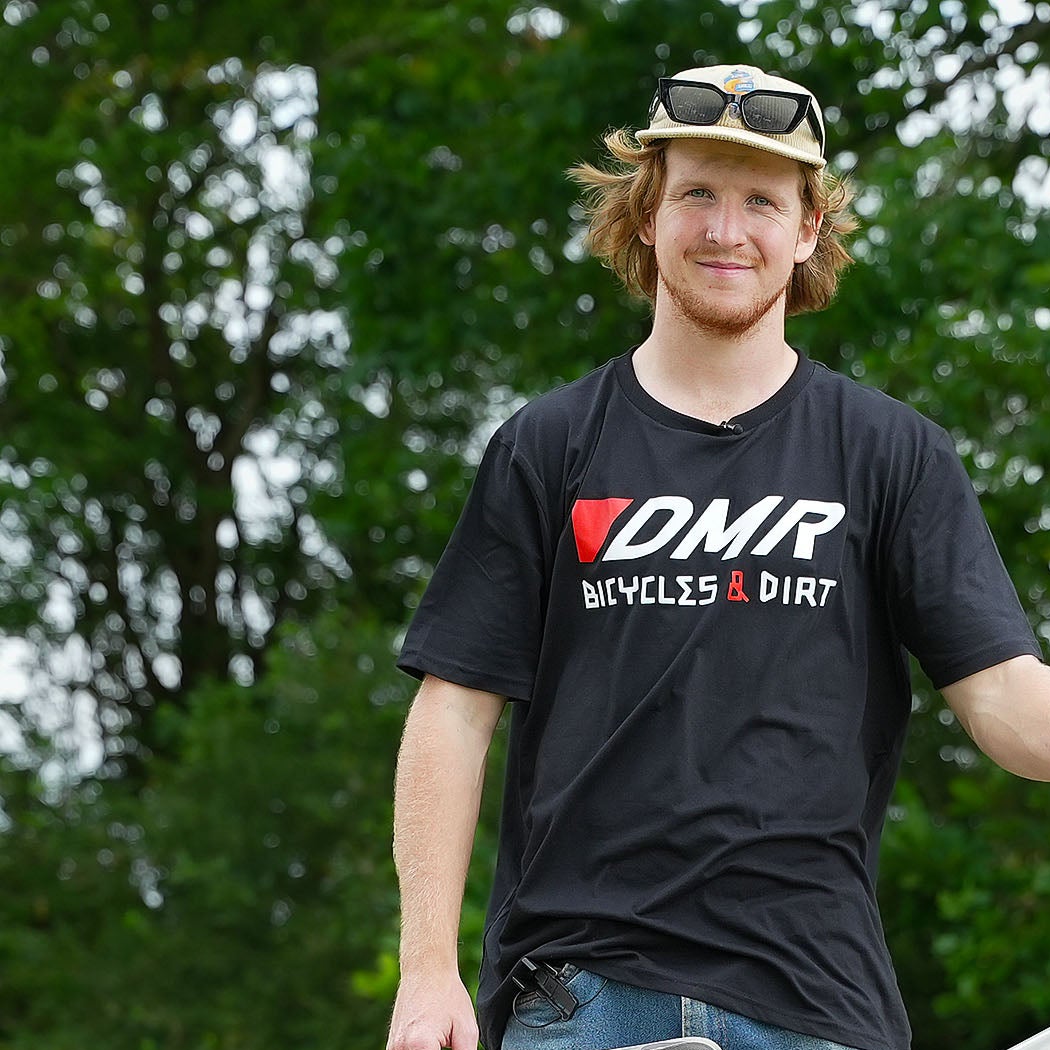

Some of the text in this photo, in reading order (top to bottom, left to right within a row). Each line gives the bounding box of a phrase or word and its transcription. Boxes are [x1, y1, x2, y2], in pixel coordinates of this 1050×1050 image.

[601, 496, 846, 562] DMR
[582, 570, 837, 609] BICYCLES & DIRT
